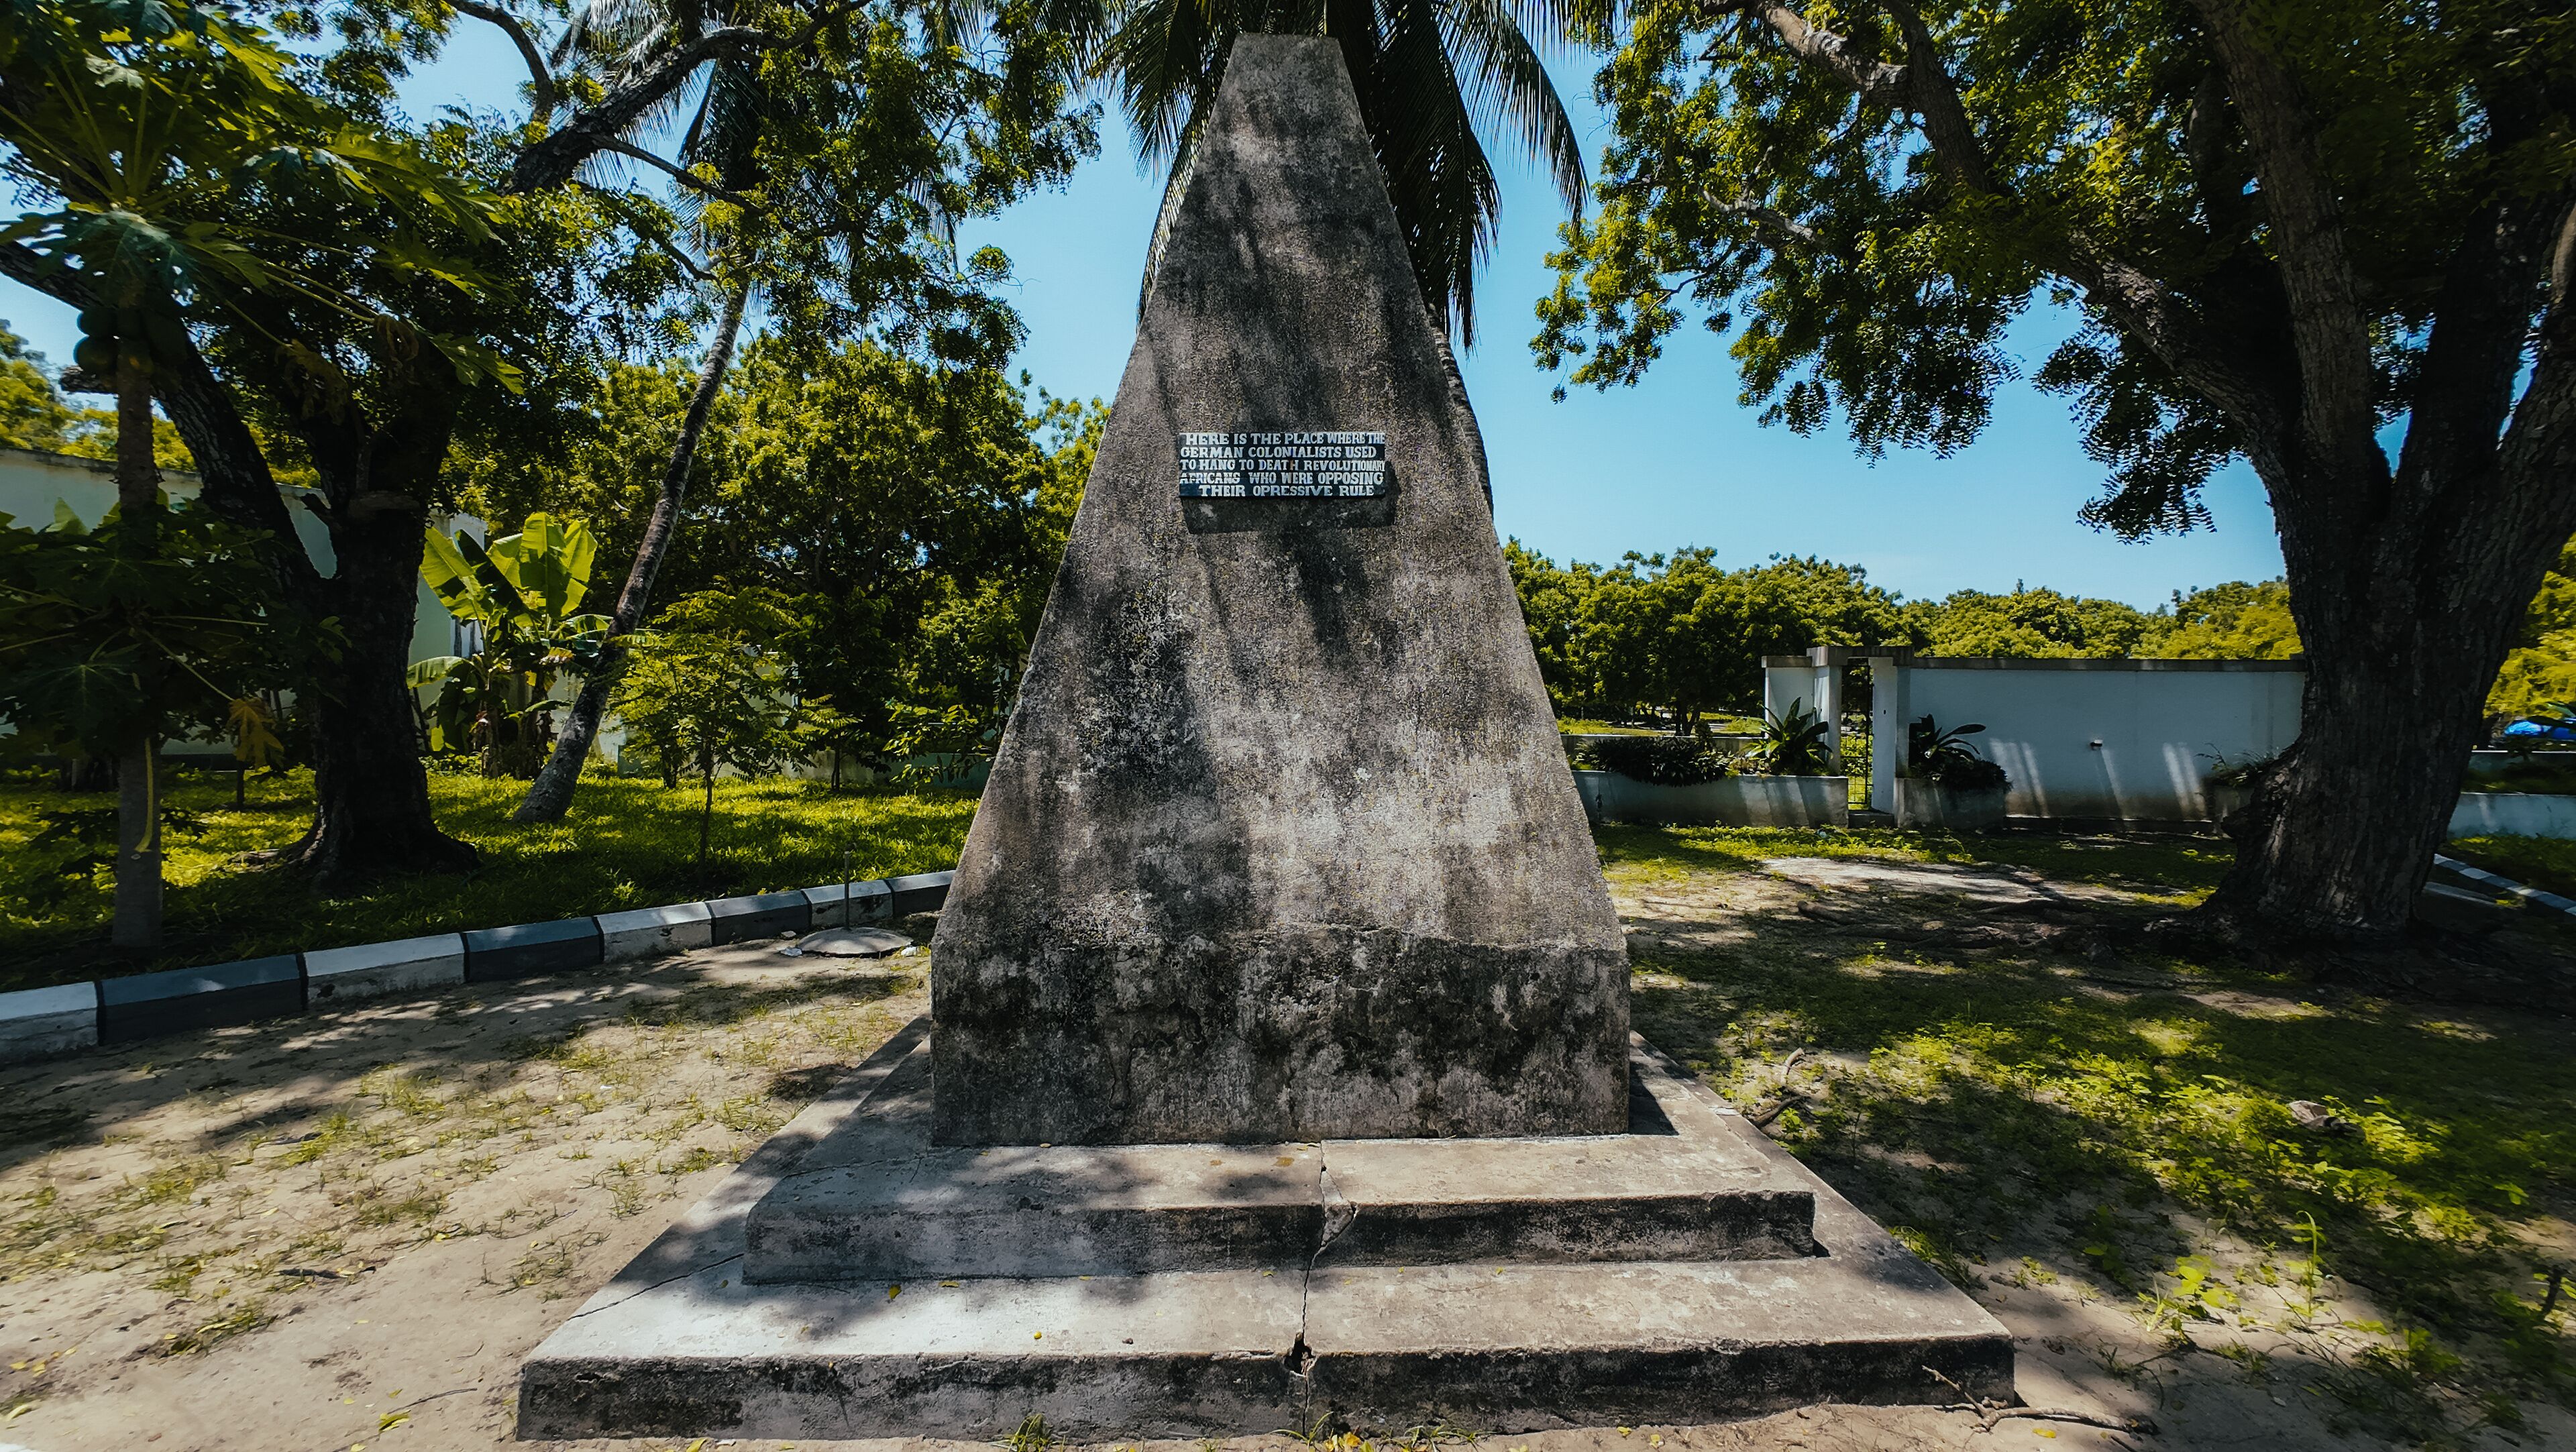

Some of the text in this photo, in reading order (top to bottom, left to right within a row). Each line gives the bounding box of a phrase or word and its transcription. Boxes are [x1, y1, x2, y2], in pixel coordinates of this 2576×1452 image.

[1186, 433, 1385, 445] HERE IS THE PLACE WHERE THE
[1181, 446, 1377, 458] GERMAN COLONIALISTS USED
[1181, 459, 1385, 471] TO HANG TO DEATH REVOLUTIONARY
[1180, 472, 1383, 484] AFRICANS WHO WERE OPPOSING
[1199, 486, 1374, 496] THEIR OPRESSIVE RULE
